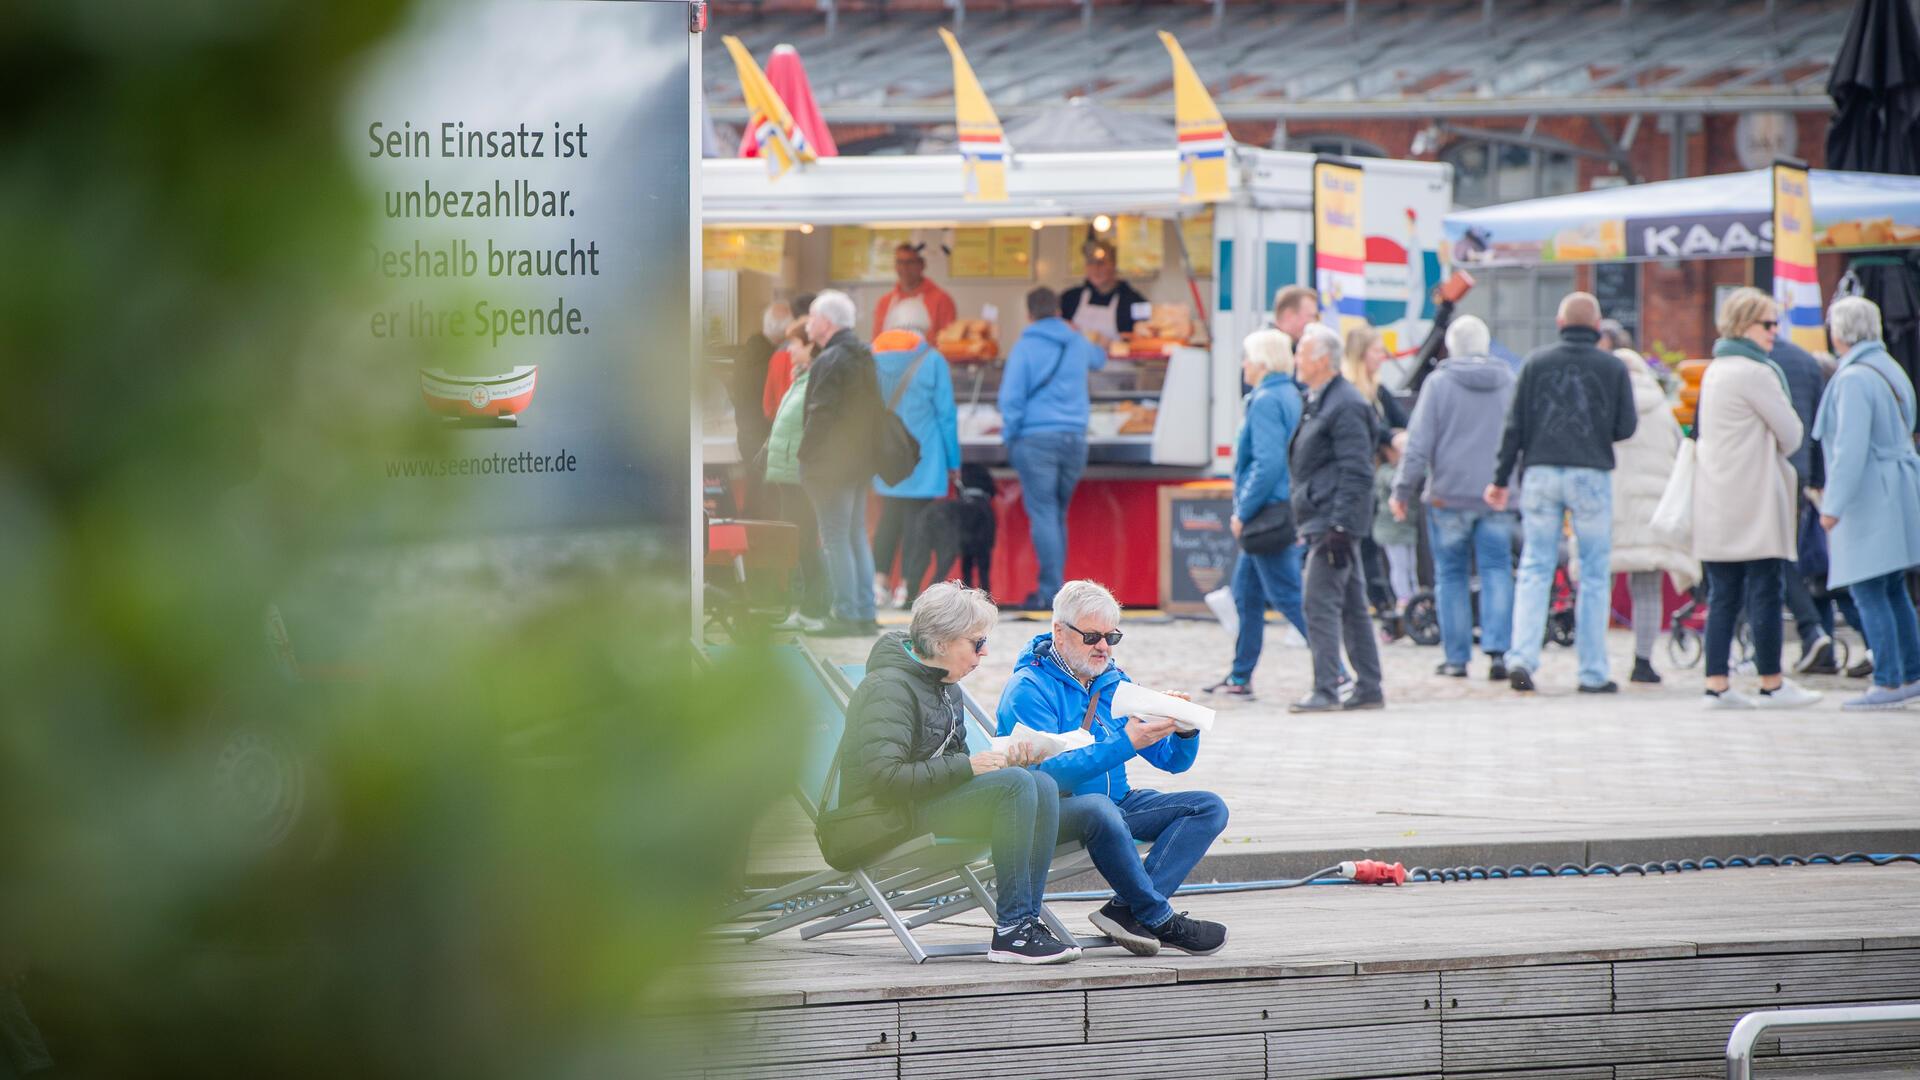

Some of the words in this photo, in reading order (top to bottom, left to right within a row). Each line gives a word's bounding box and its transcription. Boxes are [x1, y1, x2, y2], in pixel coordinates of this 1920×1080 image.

[368, 122, 430, 159] Sein
[441, 121, 544, 158] Einsatz
[554, 121, 588, 158] ist
[385, 179, 575, 219] unbezahlbar.
[488, 238, 600, 277] braucht
[370, 310, 399, 338] er
[409, 300, 465, 338] Ihre
[474, 297, 590, 348] Spende.
[385, 449, 577, 478] www.seenotretter.de
